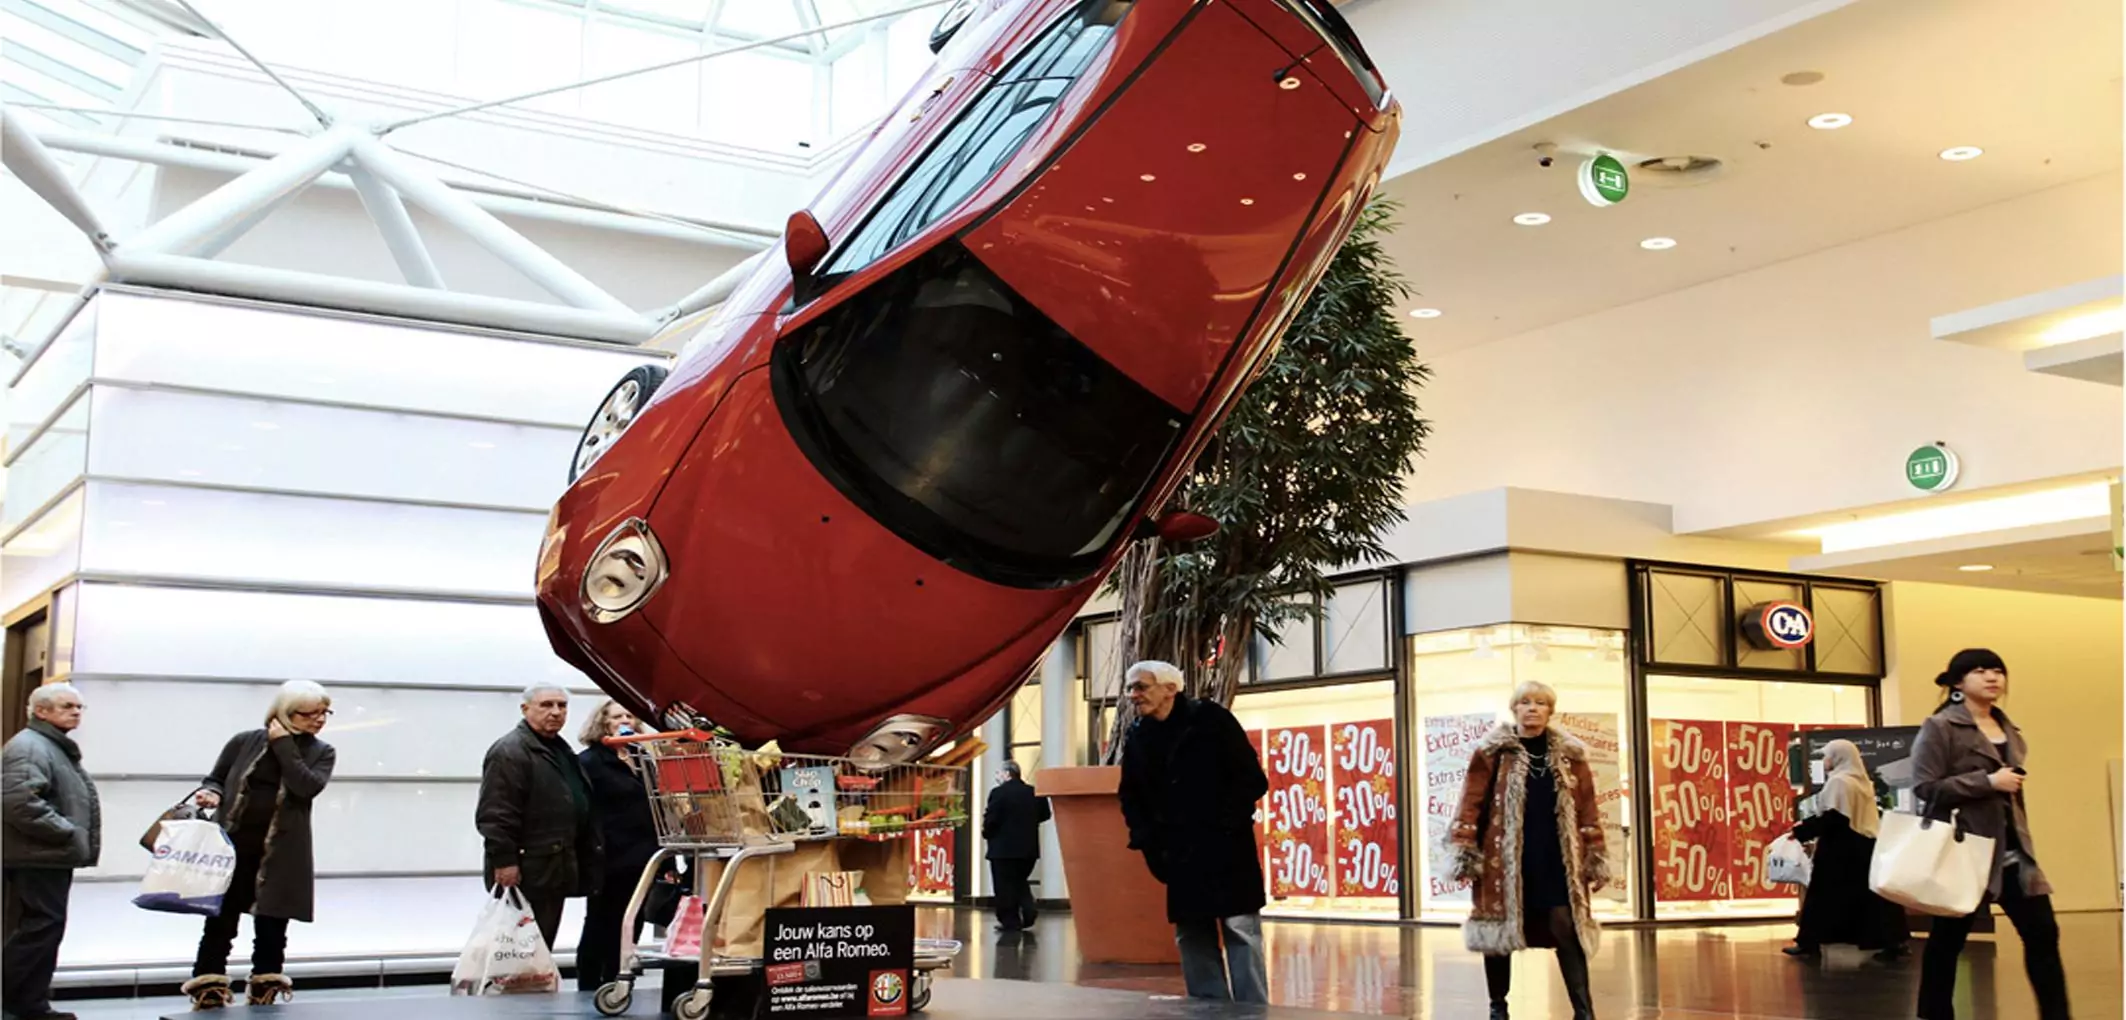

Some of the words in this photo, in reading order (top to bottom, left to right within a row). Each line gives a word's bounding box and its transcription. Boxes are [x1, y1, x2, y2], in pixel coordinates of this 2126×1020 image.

[1270, 730, 1324, 781] -30%
[1334, 724, 1394, 777] -30%
[1425, 732, 1460, 753] Extra
[1654, 721, 1723, 779] -50%
[1428, 770, 1455, 787] Extra
[1268, 784, 1326, 831] -30%
[1333, 780, 1396, 830] -30%
[1654, 780, 1725, 831] -50%
[1272, 839, 1328, 893] -30%
[1338, 838, 1398, 894] -30%
[1658, 840, 1728, 896] -50%
[773, 945, 801, 960] een
[804, 942, 833, 959] Alfa
[837, 941, 891, 958] Romeo.
[774, 923, 814, 941] Jouw
[817, 922, 852, 939] kans
[855, 924, 874, 941] op
